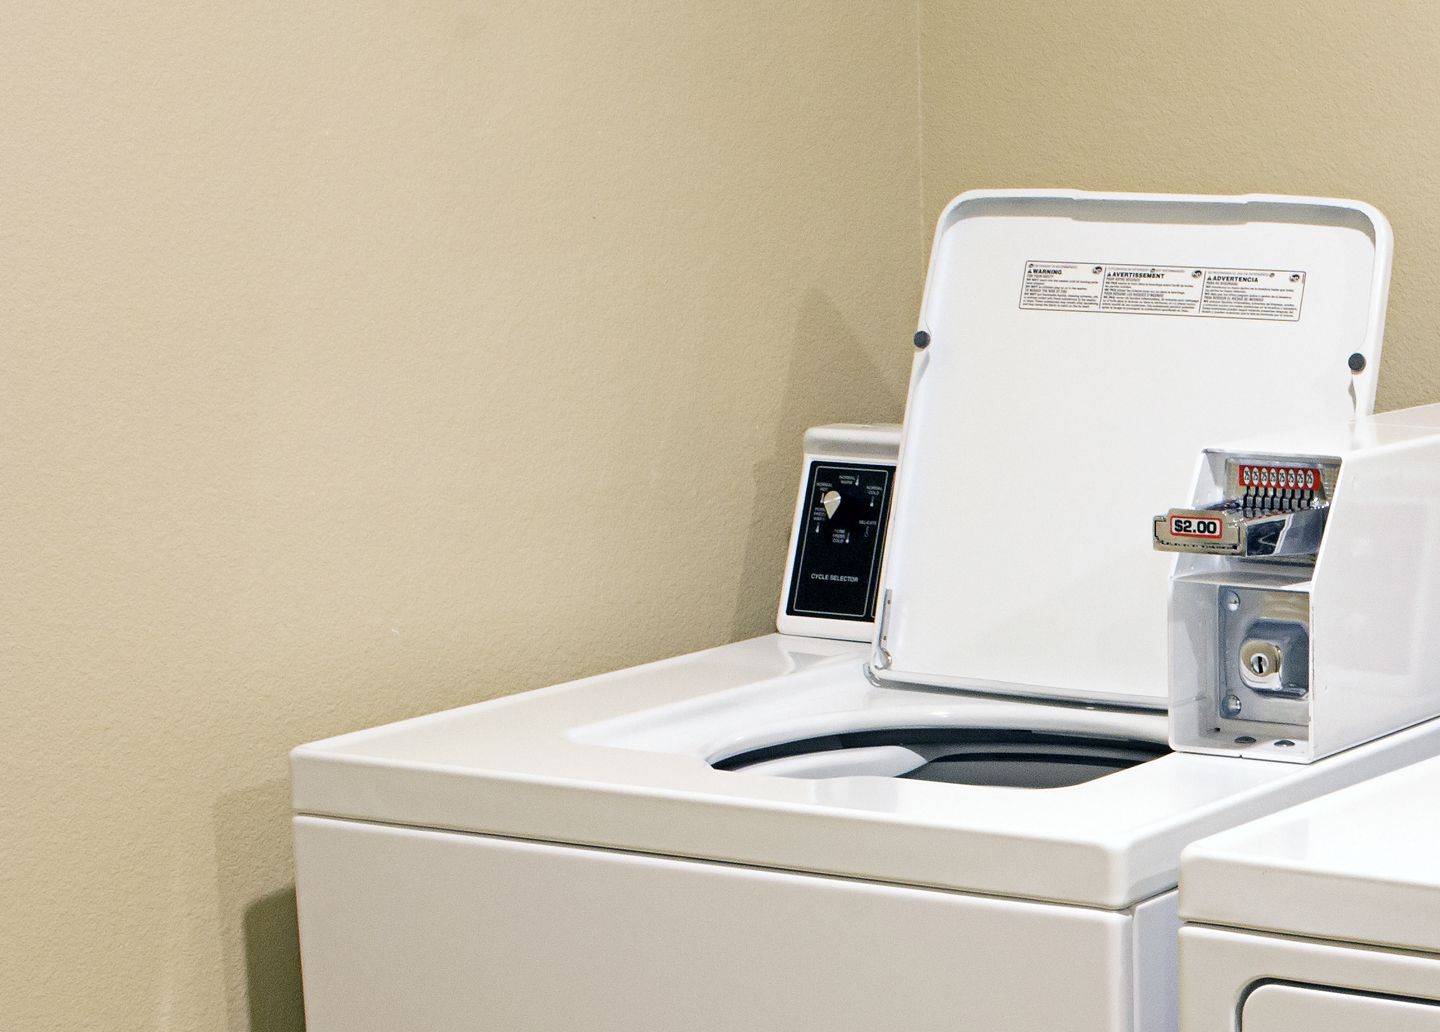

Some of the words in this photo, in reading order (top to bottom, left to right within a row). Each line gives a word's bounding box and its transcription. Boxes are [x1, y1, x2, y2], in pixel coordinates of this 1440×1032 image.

[1112, 271, 1165, 279] AVERTISSEMENT
[1213, 275, 1258, 283] ADVERTENCIA
[1174, 519, 1217, 534] $2.00
